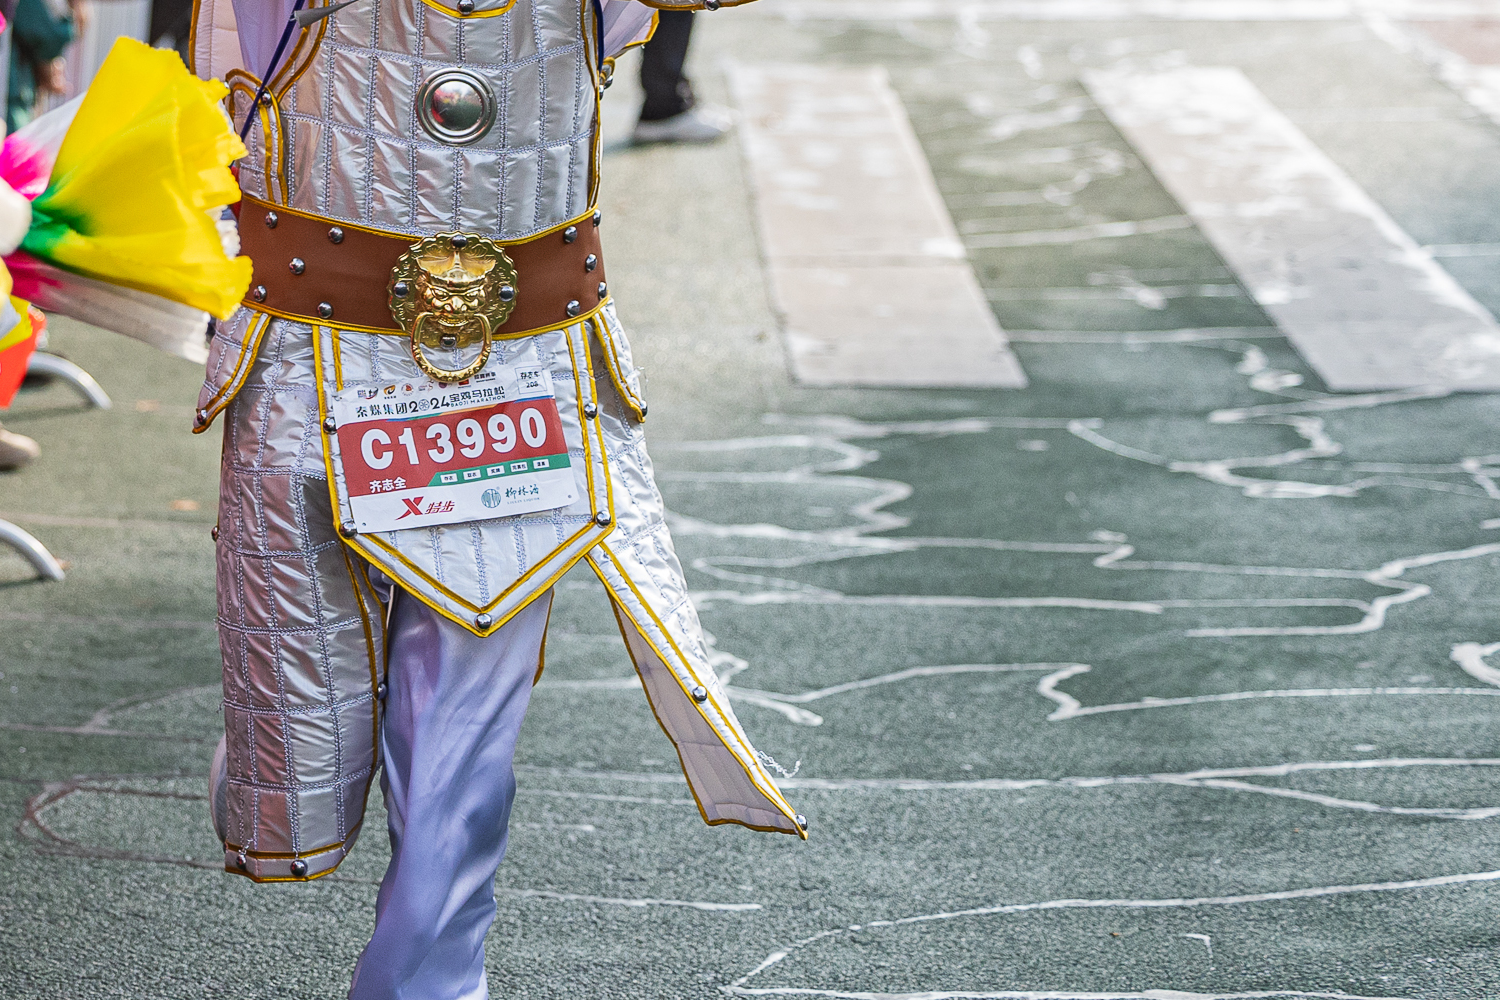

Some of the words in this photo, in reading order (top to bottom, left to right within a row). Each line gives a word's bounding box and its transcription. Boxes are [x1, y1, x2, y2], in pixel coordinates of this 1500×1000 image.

[449, 386, 504, 402] 宝鸡马拉松
[470, 395, 506, 404] MARATHON
[361, 408, 547, 470] C13990
[369, 477, 407, 493] 齐志全
[425, 501, 455, 515] 特步
